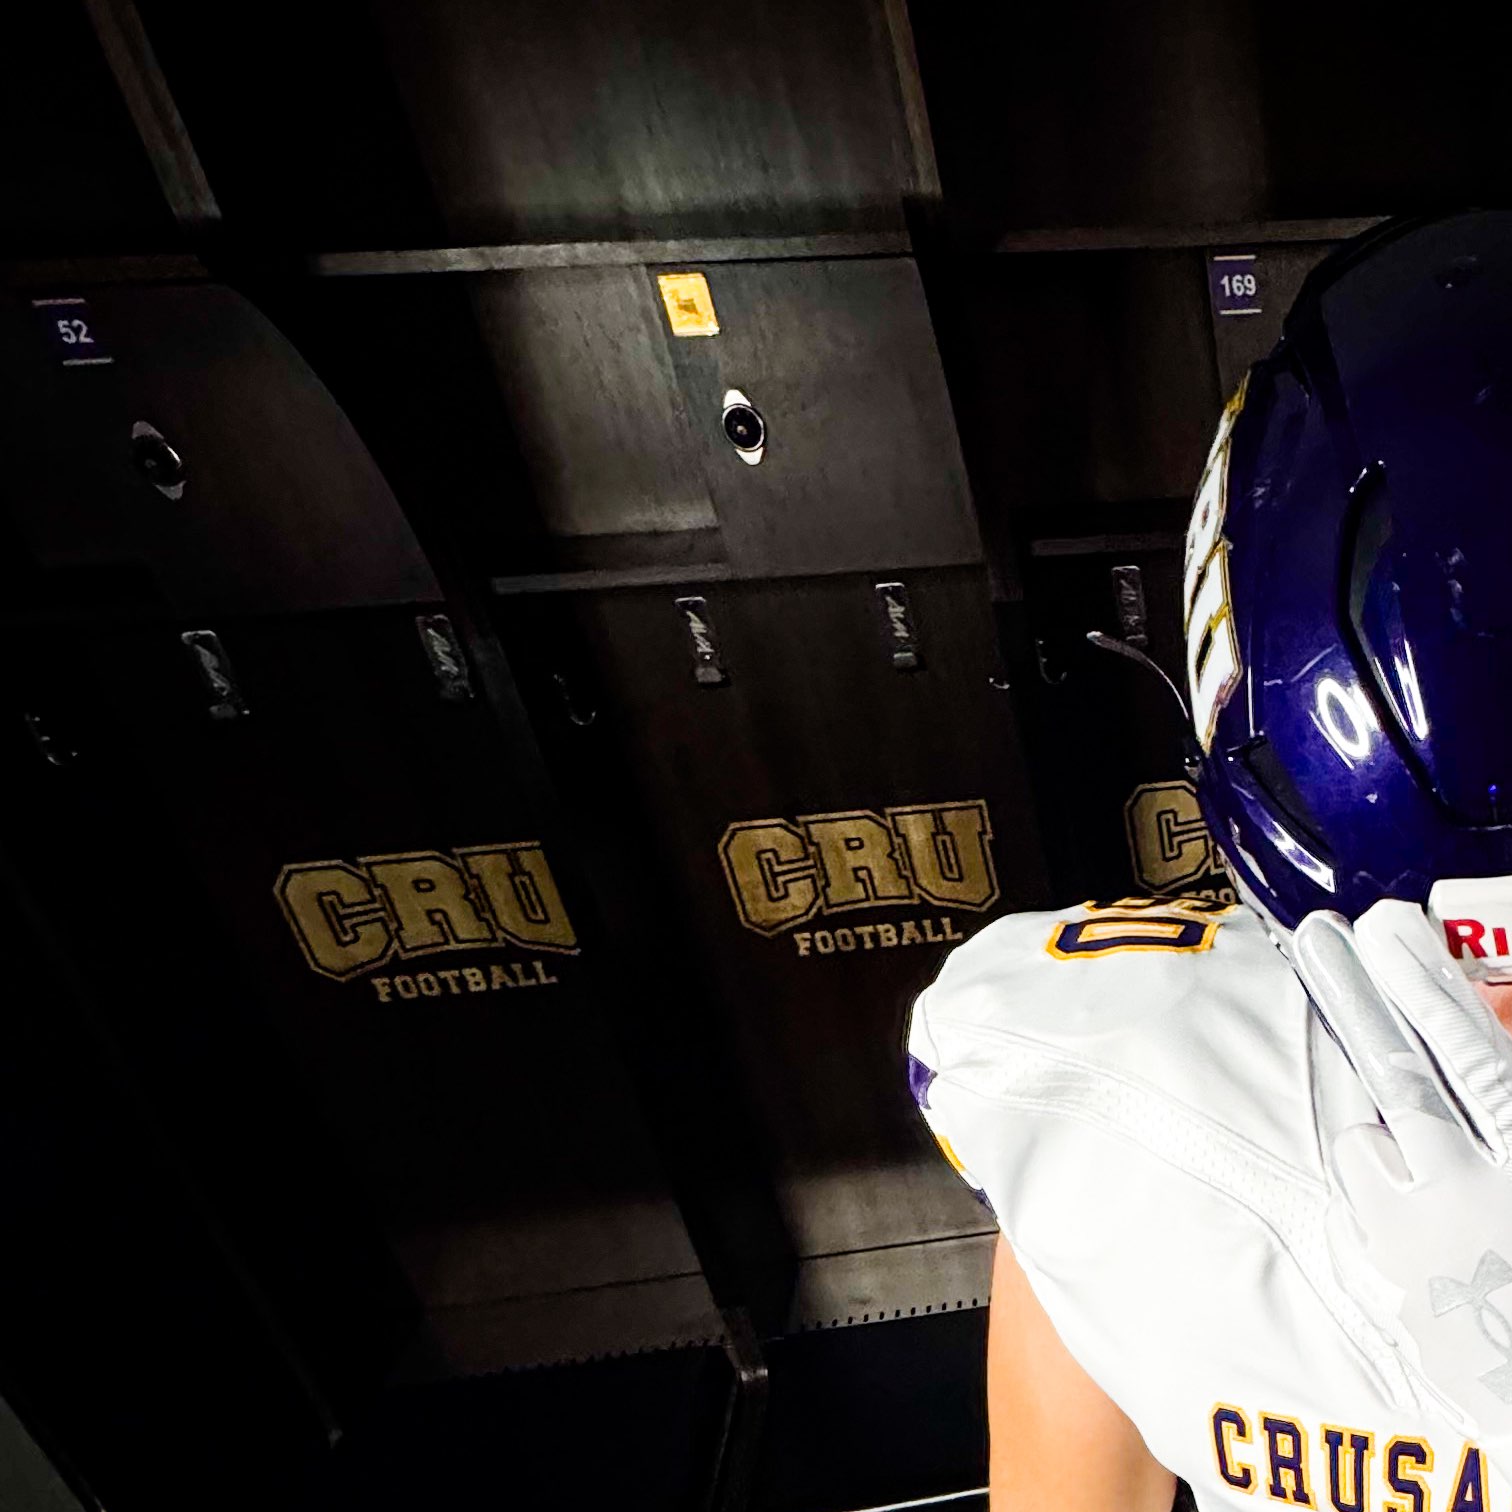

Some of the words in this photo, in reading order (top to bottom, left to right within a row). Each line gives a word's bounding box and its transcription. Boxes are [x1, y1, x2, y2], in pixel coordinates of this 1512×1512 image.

[1220, 273, 1257, 297] 169
[57, 318, 95, 344] 52
[718, 799, 1000, 939] CRU
[272, 840, 581, 984] CRU
[793, 916, 964, 956] FOOTBALL
[370, 960, 559, 1002] FOOTBALL
